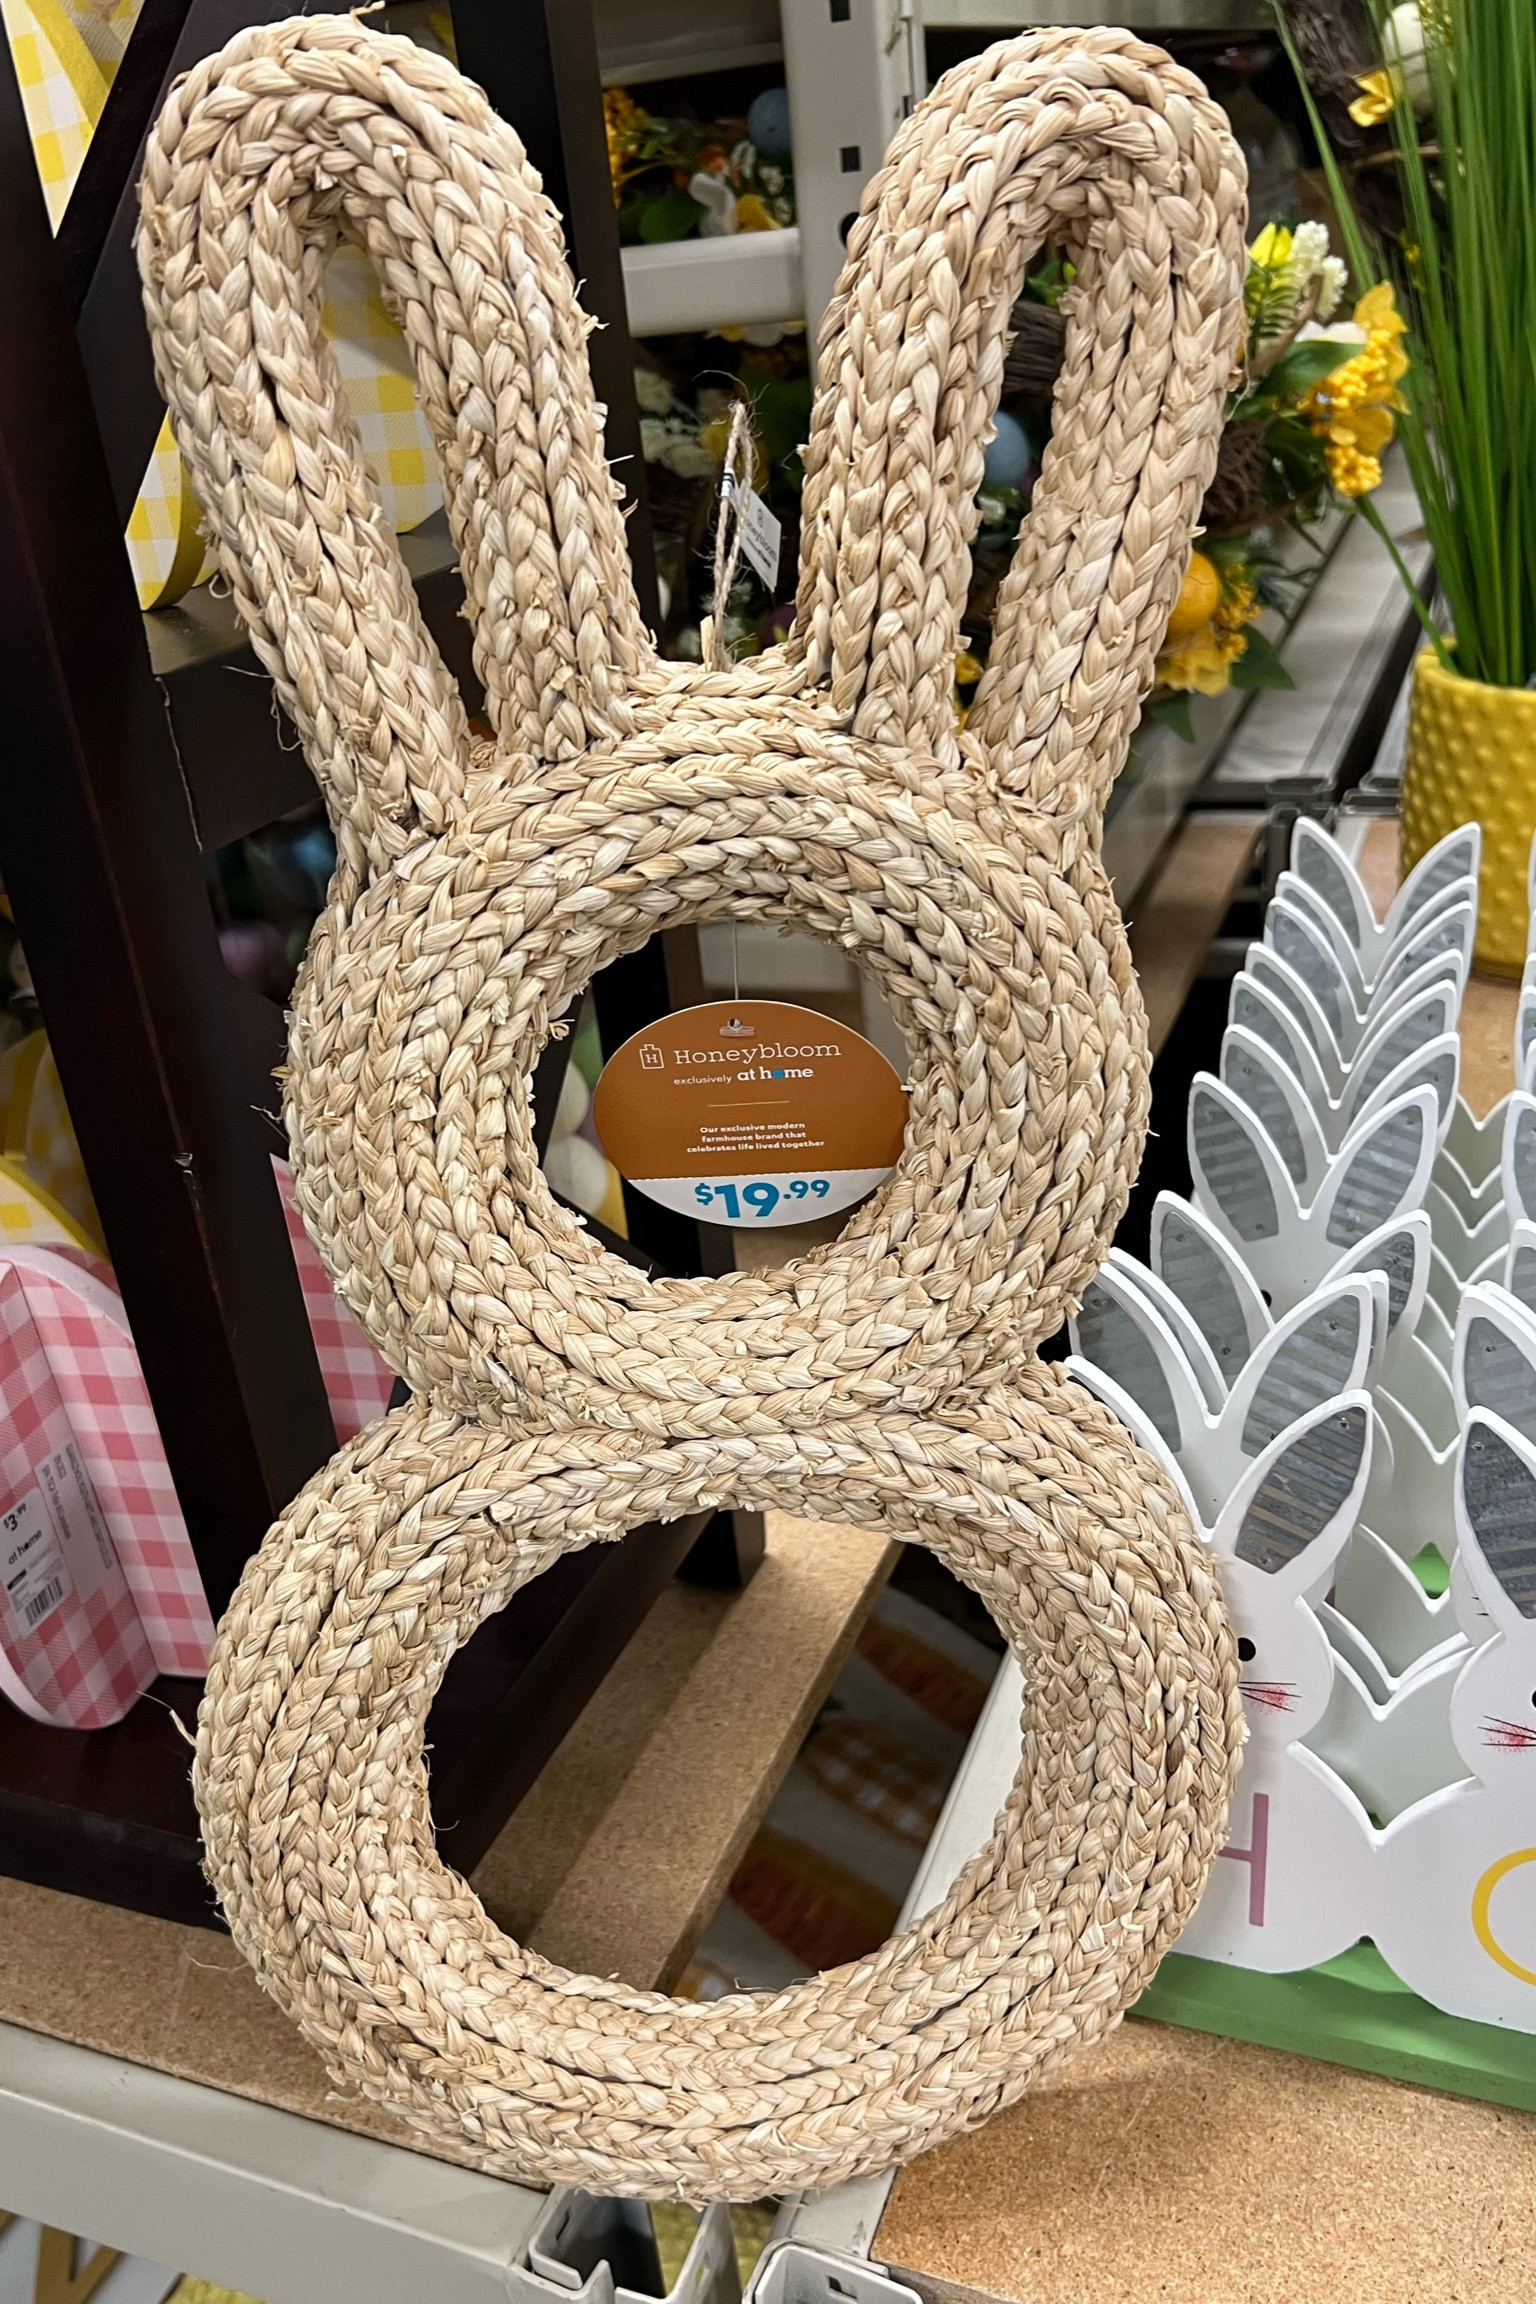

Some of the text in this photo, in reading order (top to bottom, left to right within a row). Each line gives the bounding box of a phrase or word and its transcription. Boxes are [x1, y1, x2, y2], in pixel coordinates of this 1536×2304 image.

[645, 1042, 842, 1065] H Honeybloom
[673, 1065, 814, 1086] exclusively at home
[700, 1121, 806, 1134] Our exclusive modern
[701, 1131, 807, 1143] farmhouse brand that
[686, 1139, 825, 1153] celebrates life lived together
[694, 1178, 831, 1219] $19.99
